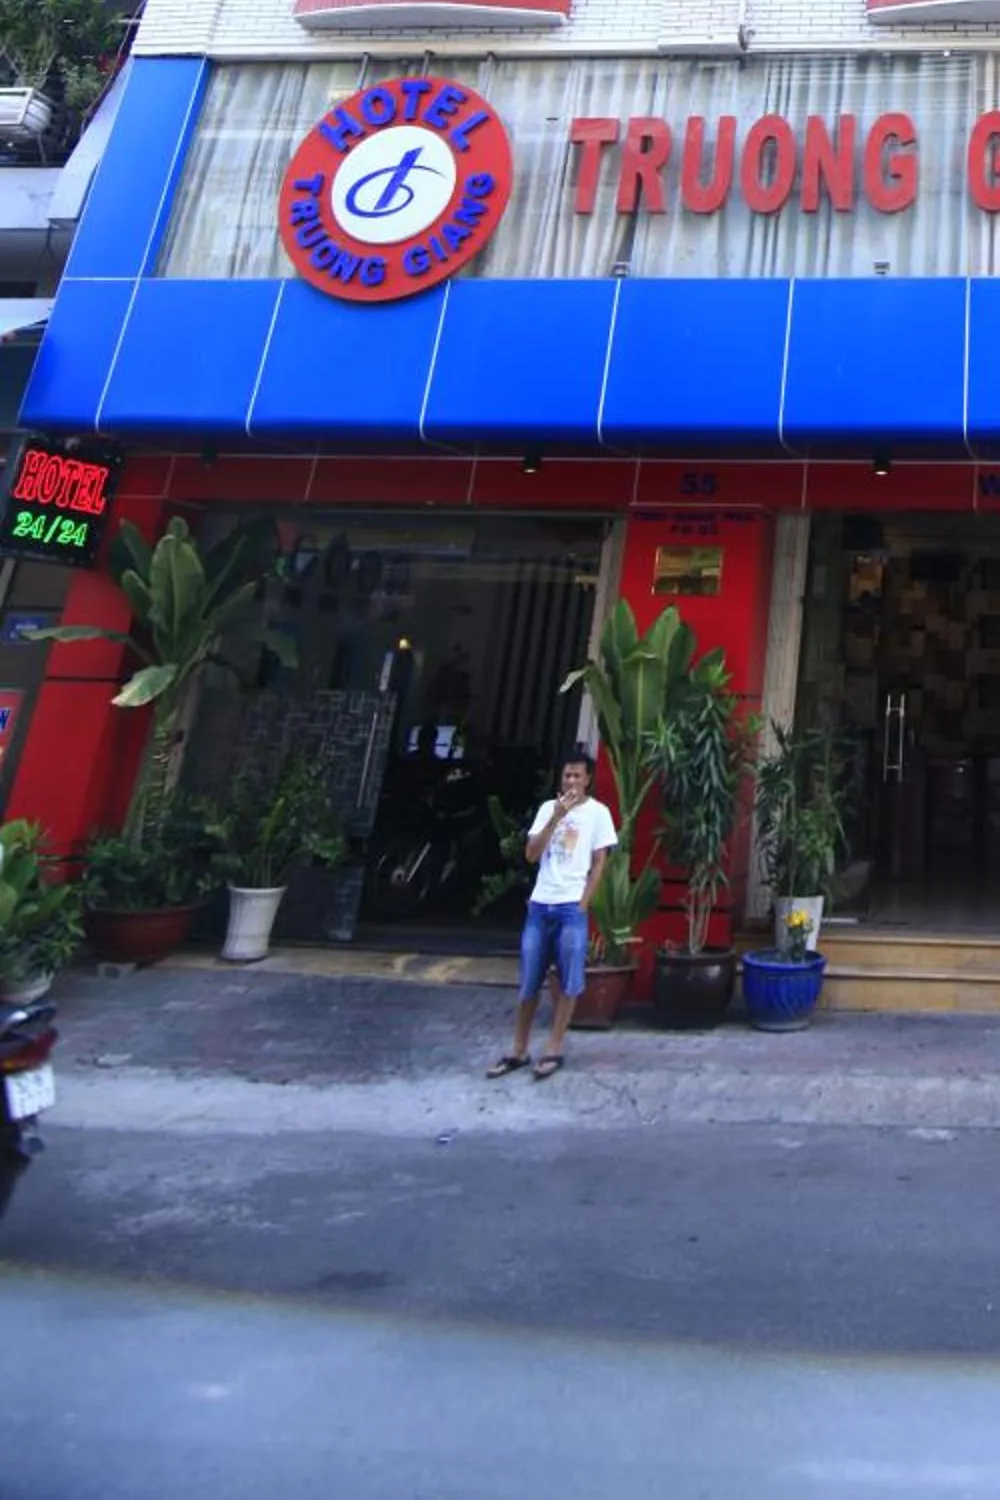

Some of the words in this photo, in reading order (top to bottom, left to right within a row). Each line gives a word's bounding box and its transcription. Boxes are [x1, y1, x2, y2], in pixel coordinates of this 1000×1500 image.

[318, 79, 490, 152] HOTEL
[570, 112, 917, 214] TRUONG
[291, 172, 388, 287] TRUONG
[403, 172, 496, 276] GIANG
[13, 450, 109, 516] HOTEL
[12, 511, 89, 547] 24/24
